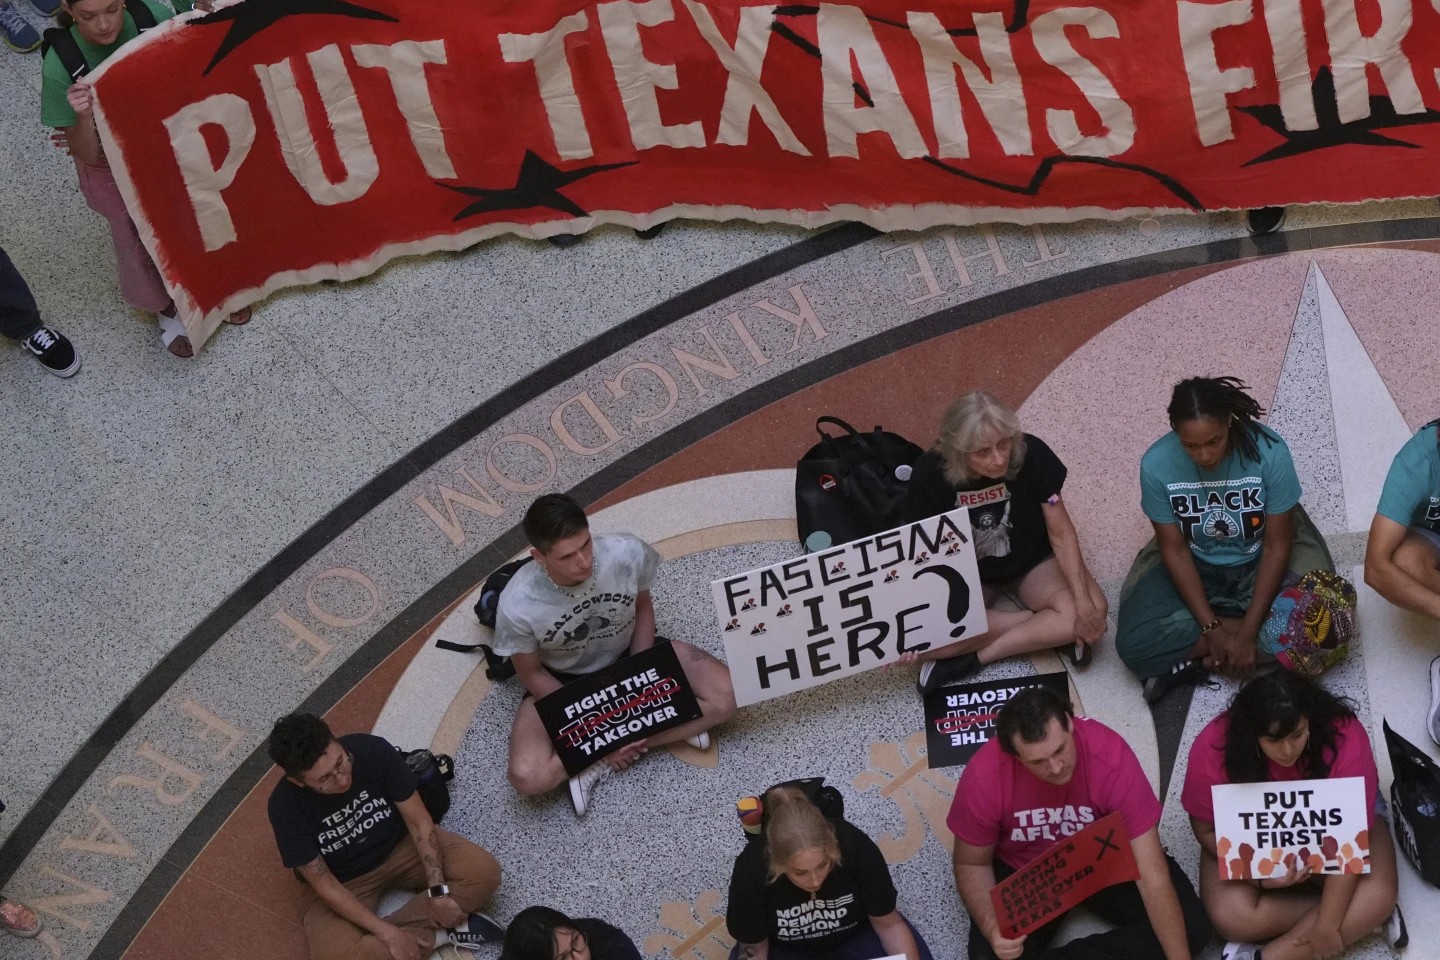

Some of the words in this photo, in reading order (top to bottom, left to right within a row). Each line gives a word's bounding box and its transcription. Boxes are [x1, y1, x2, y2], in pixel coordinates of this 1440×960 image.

[161, 38, 453, 253] PUT
[882, 223, 1072, 306] THE
[415, 282, 831, 549] KINGDOM
[959, 487, 1006, 506] RESIST
[1170, 487, 1264, 516] BLACK
[724, 515, 969, 617] FASCISM
[270, 566, 380, 673] OF
[803, 580, 874, 638] IS
[558, 677, 678, 747] TRUMP
[563, 685, 618, 720] FIGHT
[620, 667, 660, 688] THE
[580, 705, 678, 756] TAKEOVER
[951, 731, 989, 747] THE
[322, 790, 369, 827] TEXAS
[1014, 805, 1095, 827] TEXAS
[1238, 808, 1343, 830] TEXANS
[1264, 790, 1314, 809] PUT
[318, 798, 387, 844] FREEDOM
[320, 806, 392, 855] NETWORK
[1256, 829, 1327, 849] FIRST
[1002, 859, 1067, 906] LETTING
[1005, 874, 1058, 913] TRUMP
[1008, 890, 1048, 921] TAKE
[1052, 866, 1095, 895] OVER
[776, 900, 826, 919] MOMS
[777, 907, 848, 928] DEMAND
[777, 920, 840, 937] ACTION
[1010, 899, 1061, 933] TEXAS
